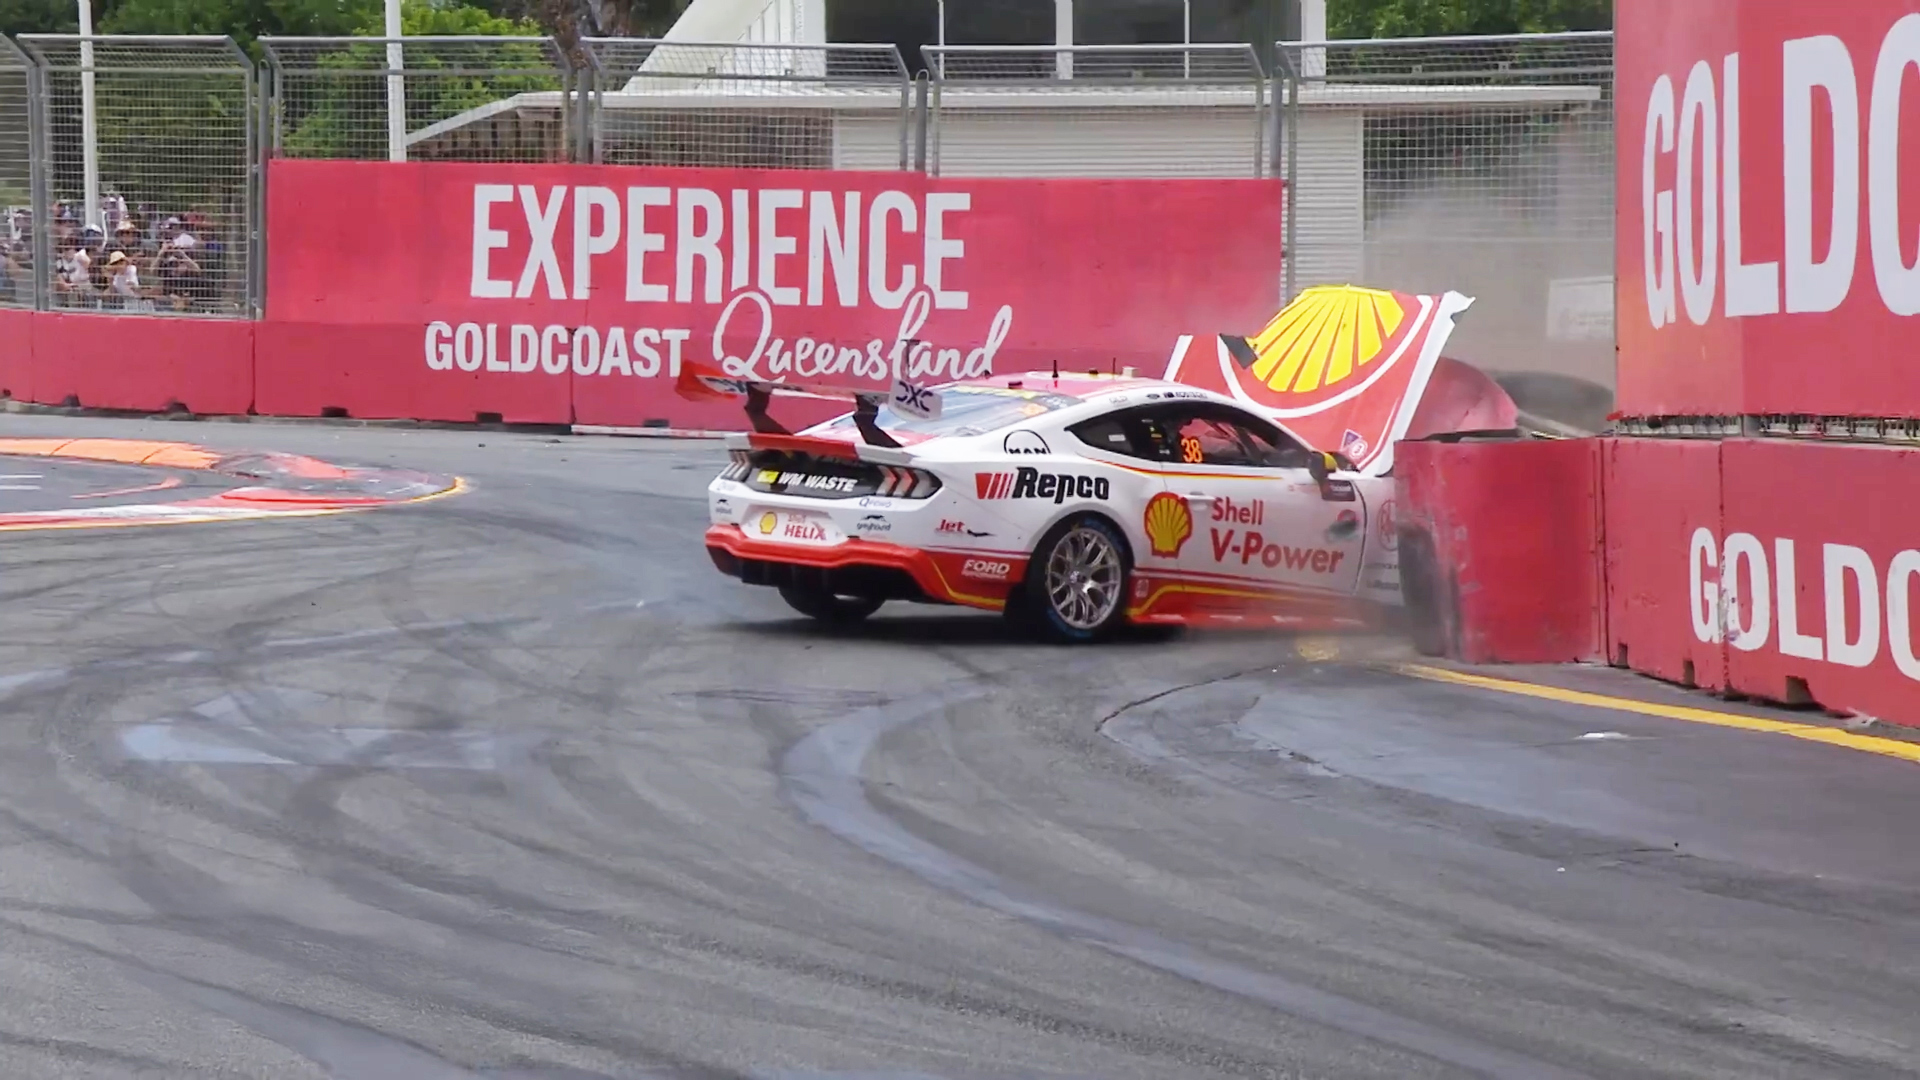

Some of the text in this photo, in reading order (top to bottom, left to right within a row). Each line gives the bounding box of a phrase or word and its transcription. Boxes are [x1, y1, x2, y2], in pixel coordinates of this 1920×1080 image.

[471, 184, 972, 310] EXPERIENCE
[424, 290, 1014, 385] GOLDCOAST Queensland
[1180, 437, 1204, 464] 38
[778, 471, 858, 492] WM WASTE
[1011, 466, 1110, 504] Repco
[1211, 495, 1264, 526] Shell
[784, 523, 827, 541] HELIX
[1209, 526, 1345, 574] V-Power
[963, 559, 1011, 575] FORD
